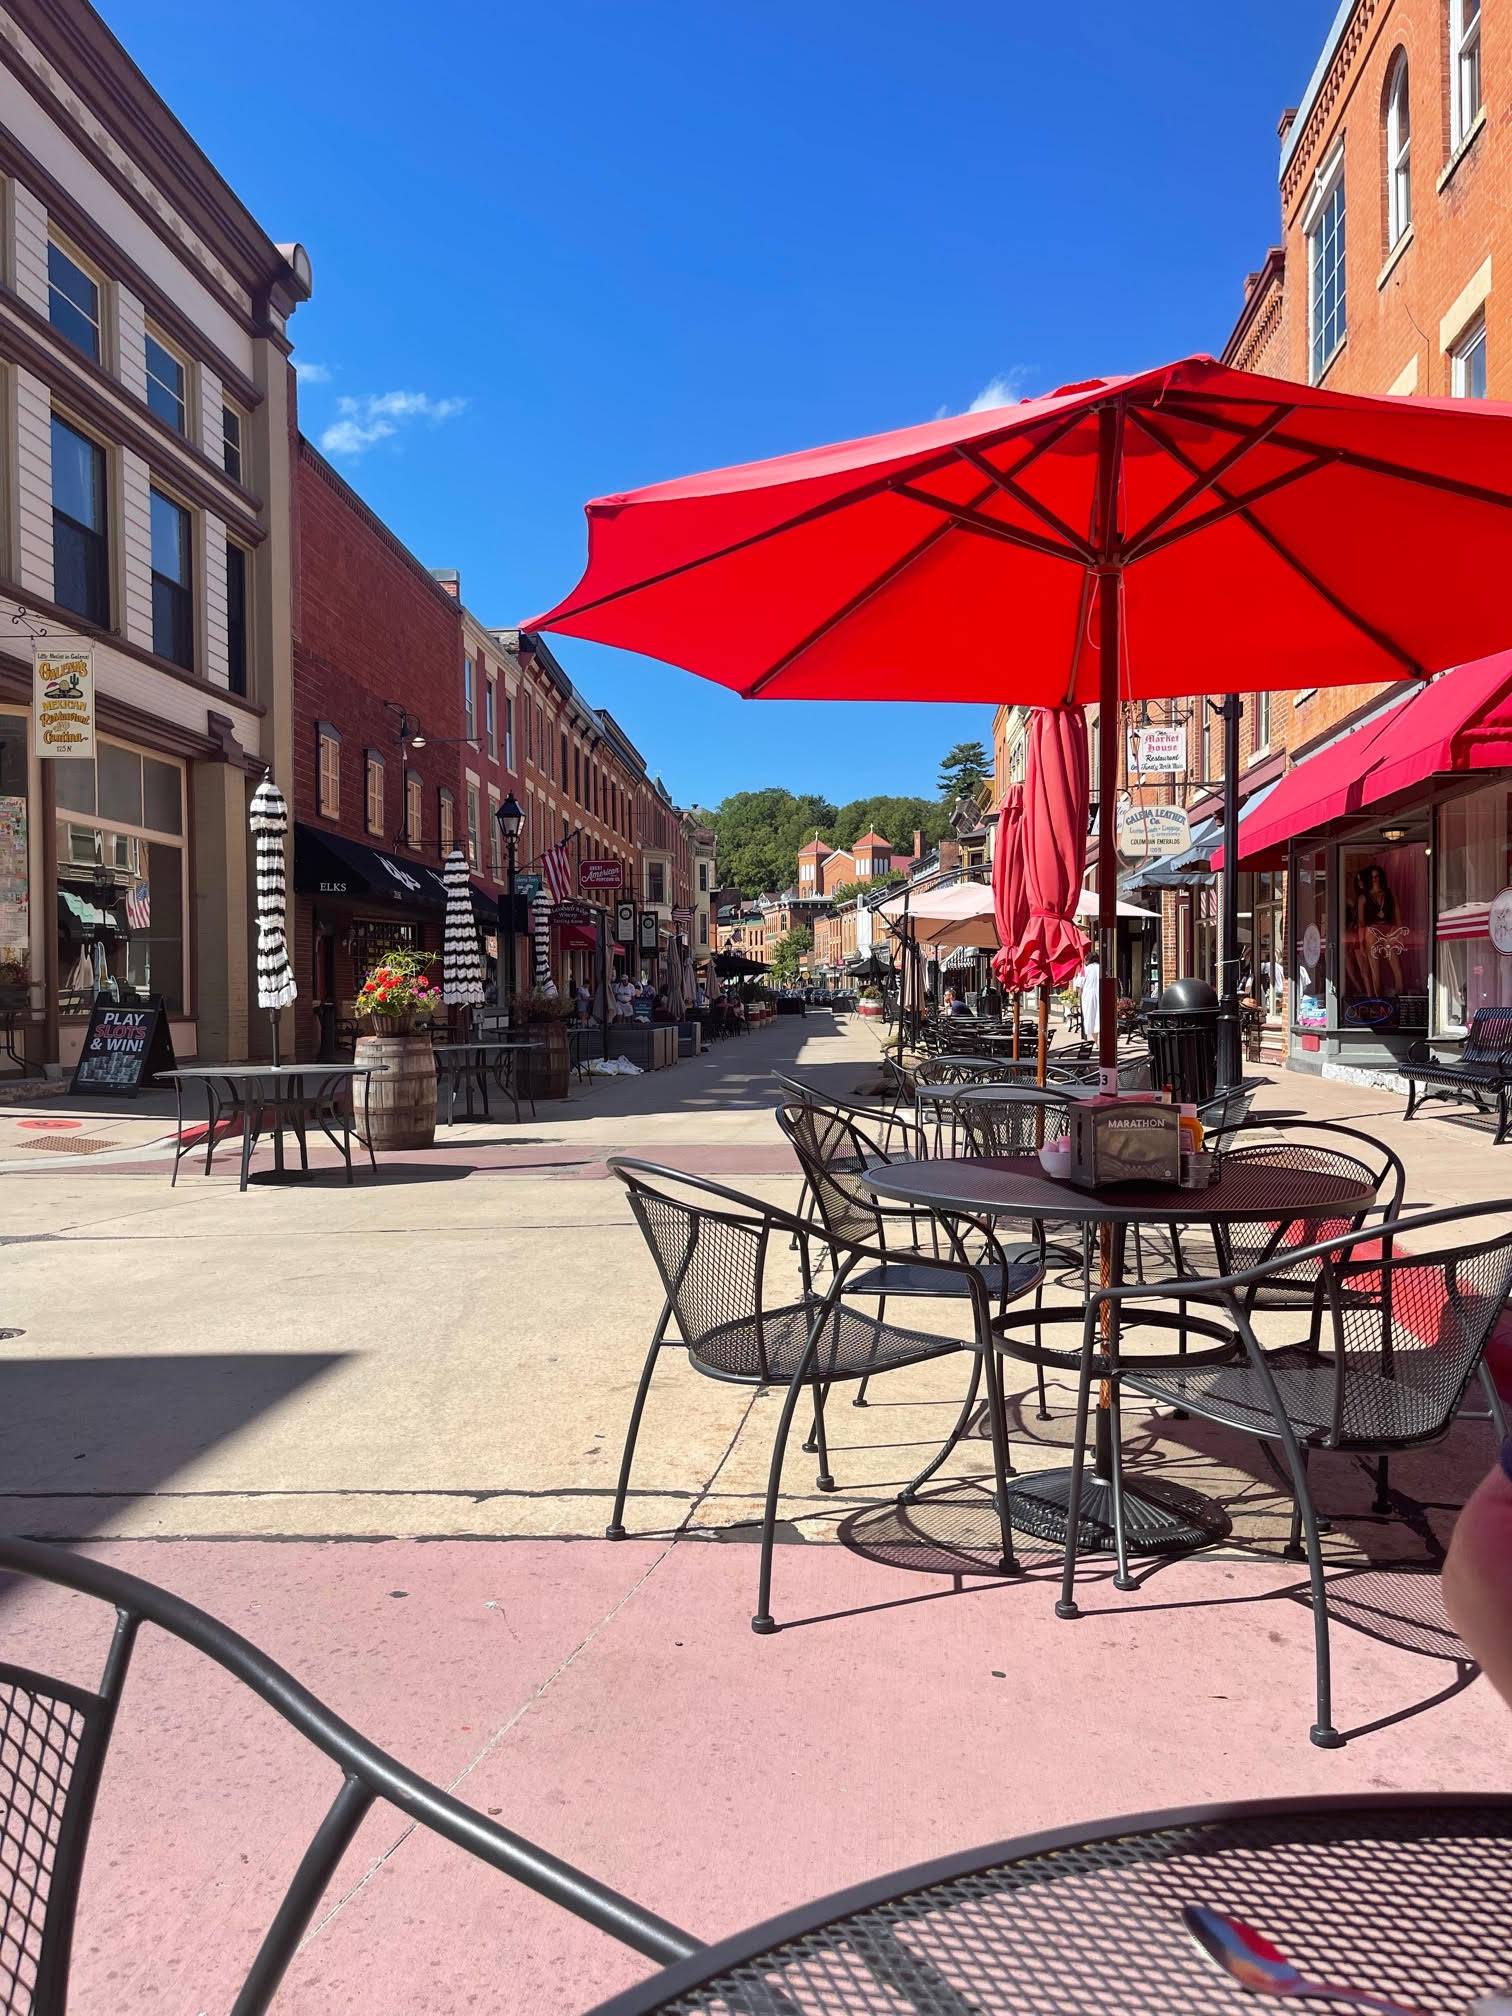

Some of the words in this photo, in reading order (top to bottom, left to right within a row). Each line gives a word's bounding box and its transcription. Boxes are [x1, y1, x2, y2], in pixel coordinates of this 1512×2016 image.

[42, 700, 87, 712] MEXICAN
[43, 729, 89, 744] Cantina
[1144, 734, 1179, 744] Market
[1145, 753, 1179, 762] Restaurant
[1125, 809, 1154, 825] GALENA
[1155, 809, 1186, 825] LEATHER
[581, 868, 620, 882] American
[320, 882, 347, 892] ELKS
[103, 1012, 144, 1026] PLAY
[94, 1024, 147, 1039] SLOTS
[90, 1038, 102, 1050] &
[106, 1039, 144, 1052] WIN!
[1108, 1119, 1165, 1128] MARATHON
